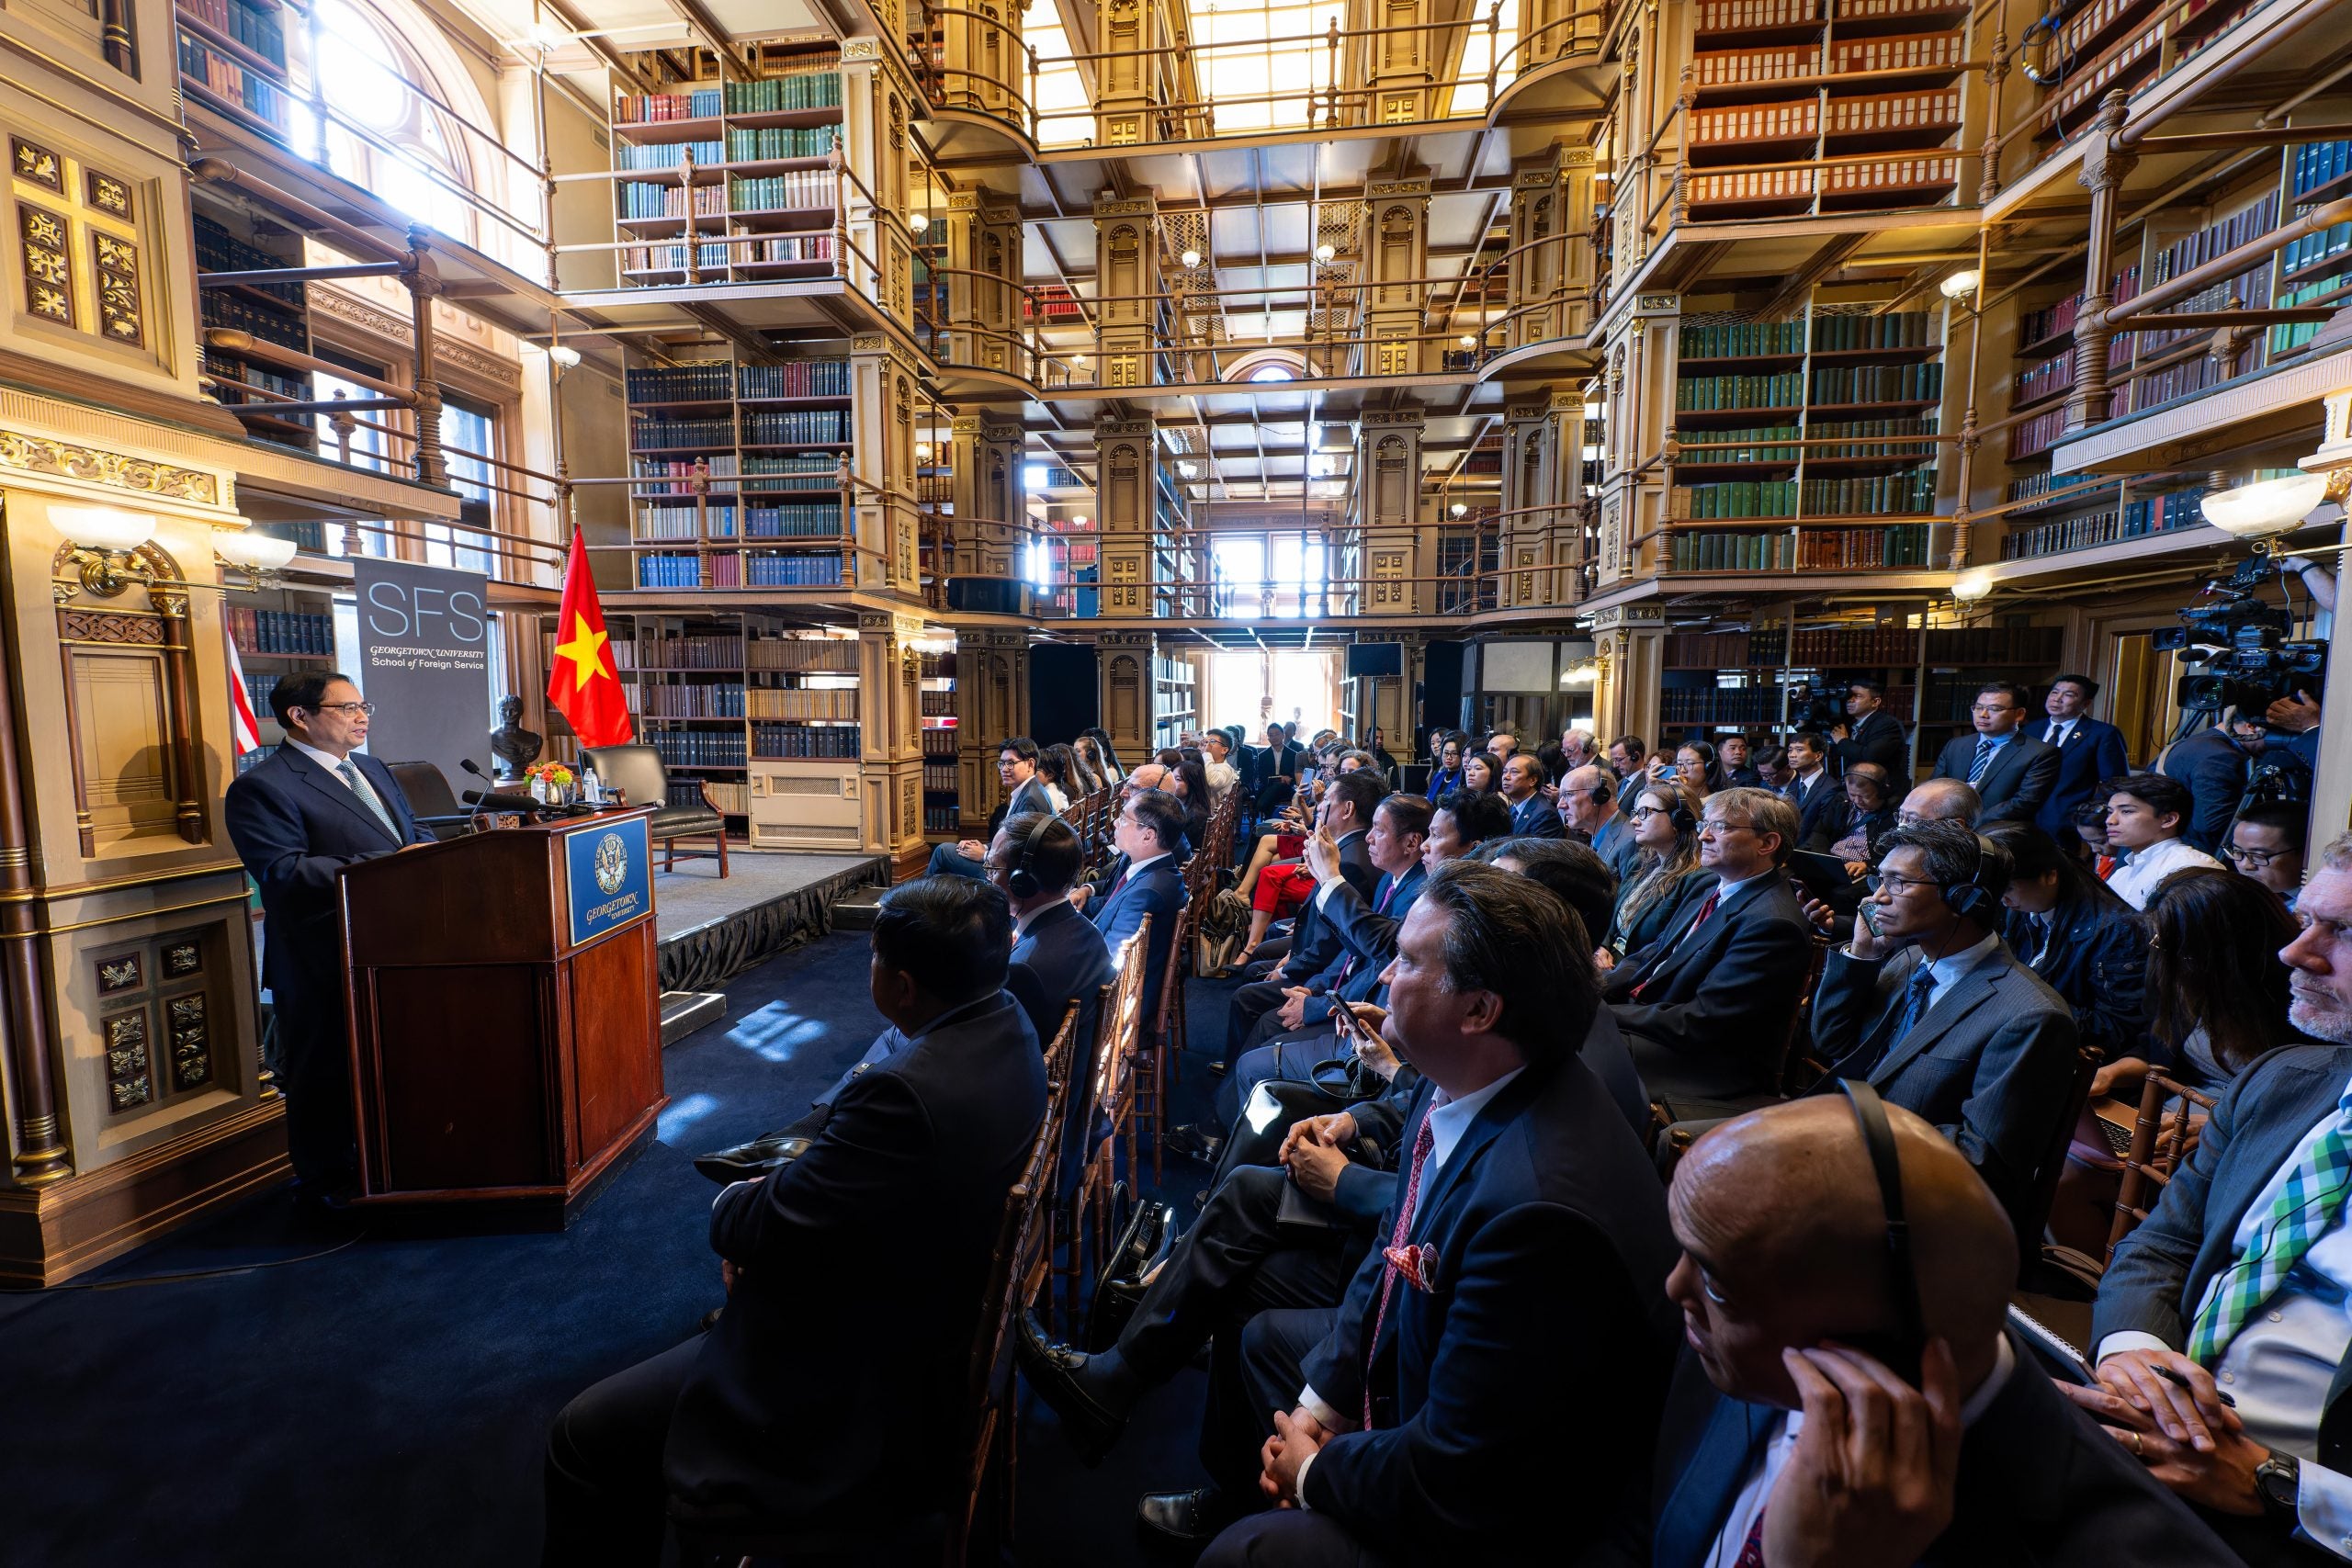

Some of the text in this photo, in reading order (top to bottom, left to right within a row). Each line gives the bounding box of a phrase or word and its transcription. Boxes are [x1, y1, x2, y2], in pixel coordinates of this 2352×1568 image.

[368, 581, 483, 642] SFS
[370, 645, 484, 659] GEORGETOWN UNIVERSITY
[371, 657, 484, 670] School of Foreign Service
[586, 891, 639, 925] GEORGETOWN
[611, 905, 635, 920] UNIVERSITY
